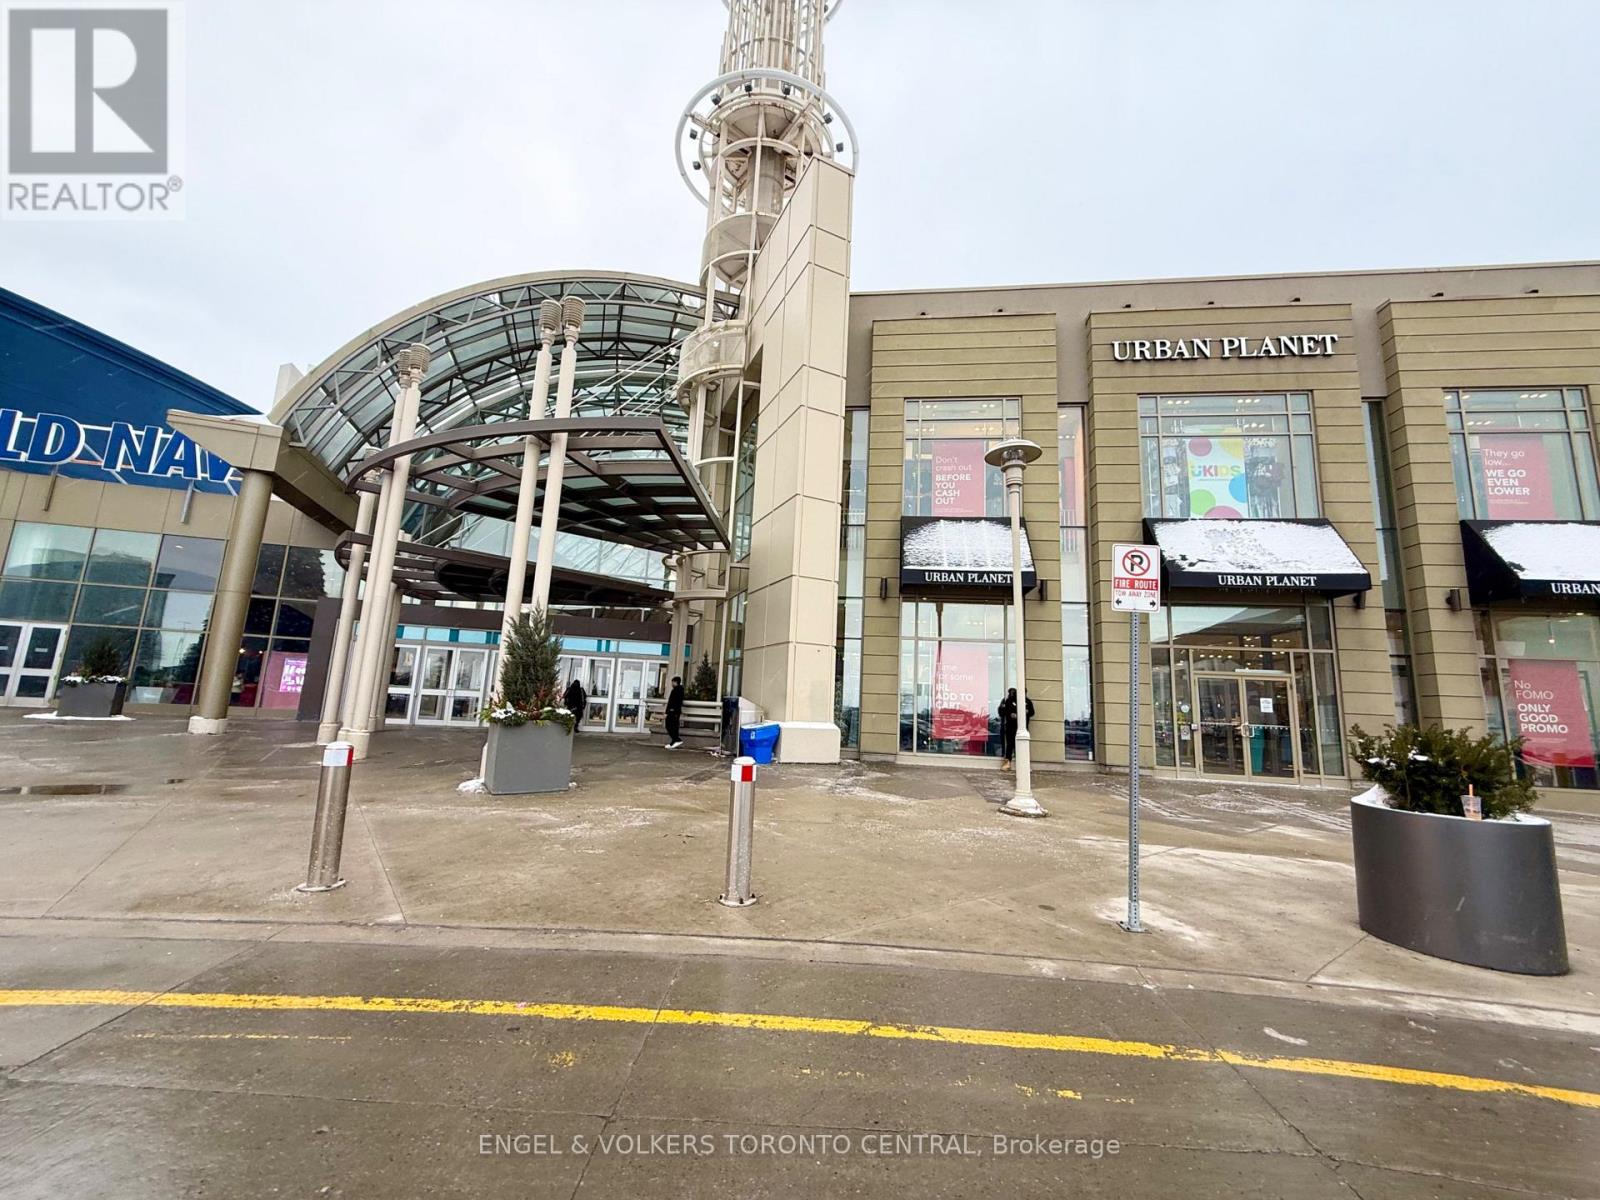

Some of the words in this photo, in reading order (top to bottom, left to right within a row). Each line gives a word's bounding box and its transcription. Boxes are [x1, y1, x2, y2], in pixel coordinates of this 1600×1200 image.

[1111, 338, 1212, 361] URBAN
[1220, 334, 1339, 358] PLANET
[1482, 448, 1507, 459] They
[1511, 450, 1525, 459] go
[935, 473, 972, 481] BEFORE
[1485, 469, 1505, 478] WE
[1508, 469, 1526, 478] GO
[935, 481, 955, 490] YOU
[1487, 478, 1519, 486] EVEN
[935, 489, 960, 498] CASH
[1488, 486, 1531, 496] LOWER
[935, 497, 954, 505] OUT
[925, 571, 964, 583] URBAN
[967, 572, 1013, 584] PLANET
[1217, 574, 1262, 586] URBAN
[1265, 575, 1317, 587] PLANET
[1115, 579, 1130, 588] FIRE
[1135, 580, 1157, 590] ROUTE
[1550, 582, 1600, 595] URBAN
[1514, 680, 1531, 689] No
[935, 692, 957, 701] ADD
[960, 692, 974, 702] TO
[1515, 690, 1554, 700] FOMO
[1517, 703, 1551, 713] ONLY
[1519, 713, 1559, 723] GOOD
[1520, 723, 1568, 734] PROMO
